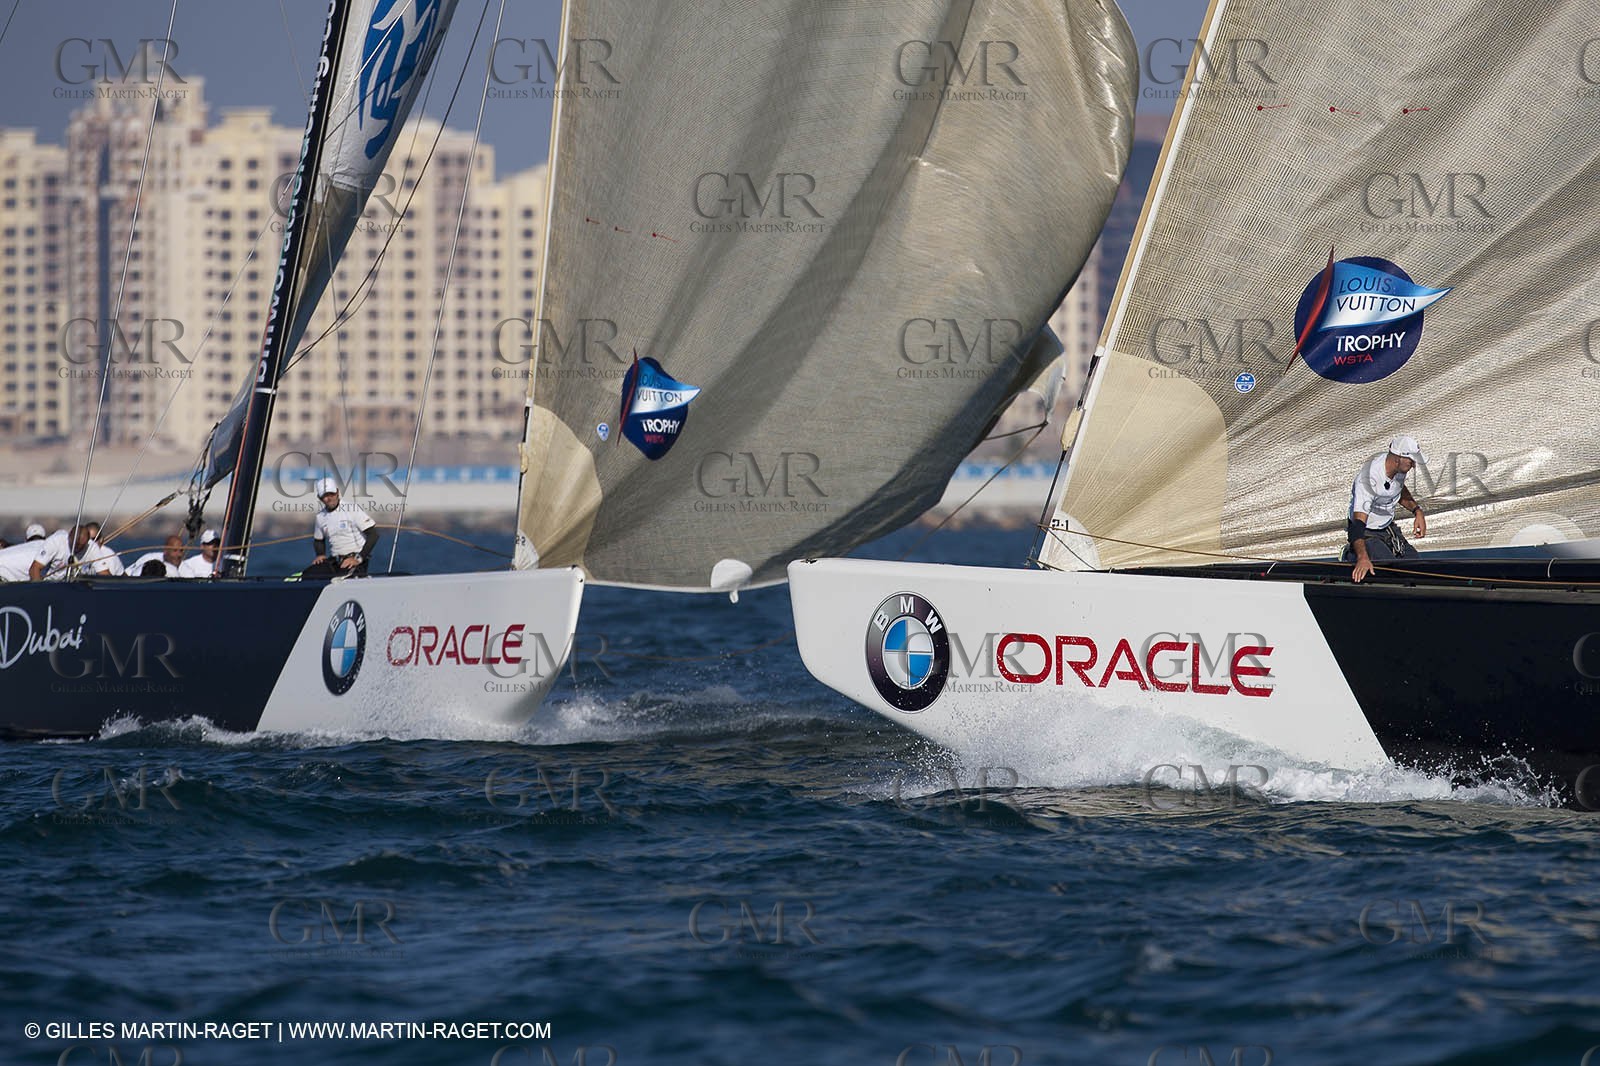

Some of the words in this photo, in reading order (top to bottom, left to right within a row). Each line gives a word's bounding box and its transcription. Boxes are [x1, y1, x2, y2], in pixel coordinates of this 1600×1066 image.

[1339, 277, 1393, 294] LOUIS
[1336, 296, 1416, 312] VUITTON
[1335, 332, 1406, 352] TROPHY
[1333, 354, 1374, 365] WSTA
[636, 390, 683, 403] VUITTON
[641, 418, 680, 435] TROPHY
[329, 602, 365, 633] BMW
[873, 596, 943, 634] BMW
[0, 604, 87, 669] Dubai
[386, 624, 526, 667] ORACLE
[996, 632, 1275, 698] ORACLE
